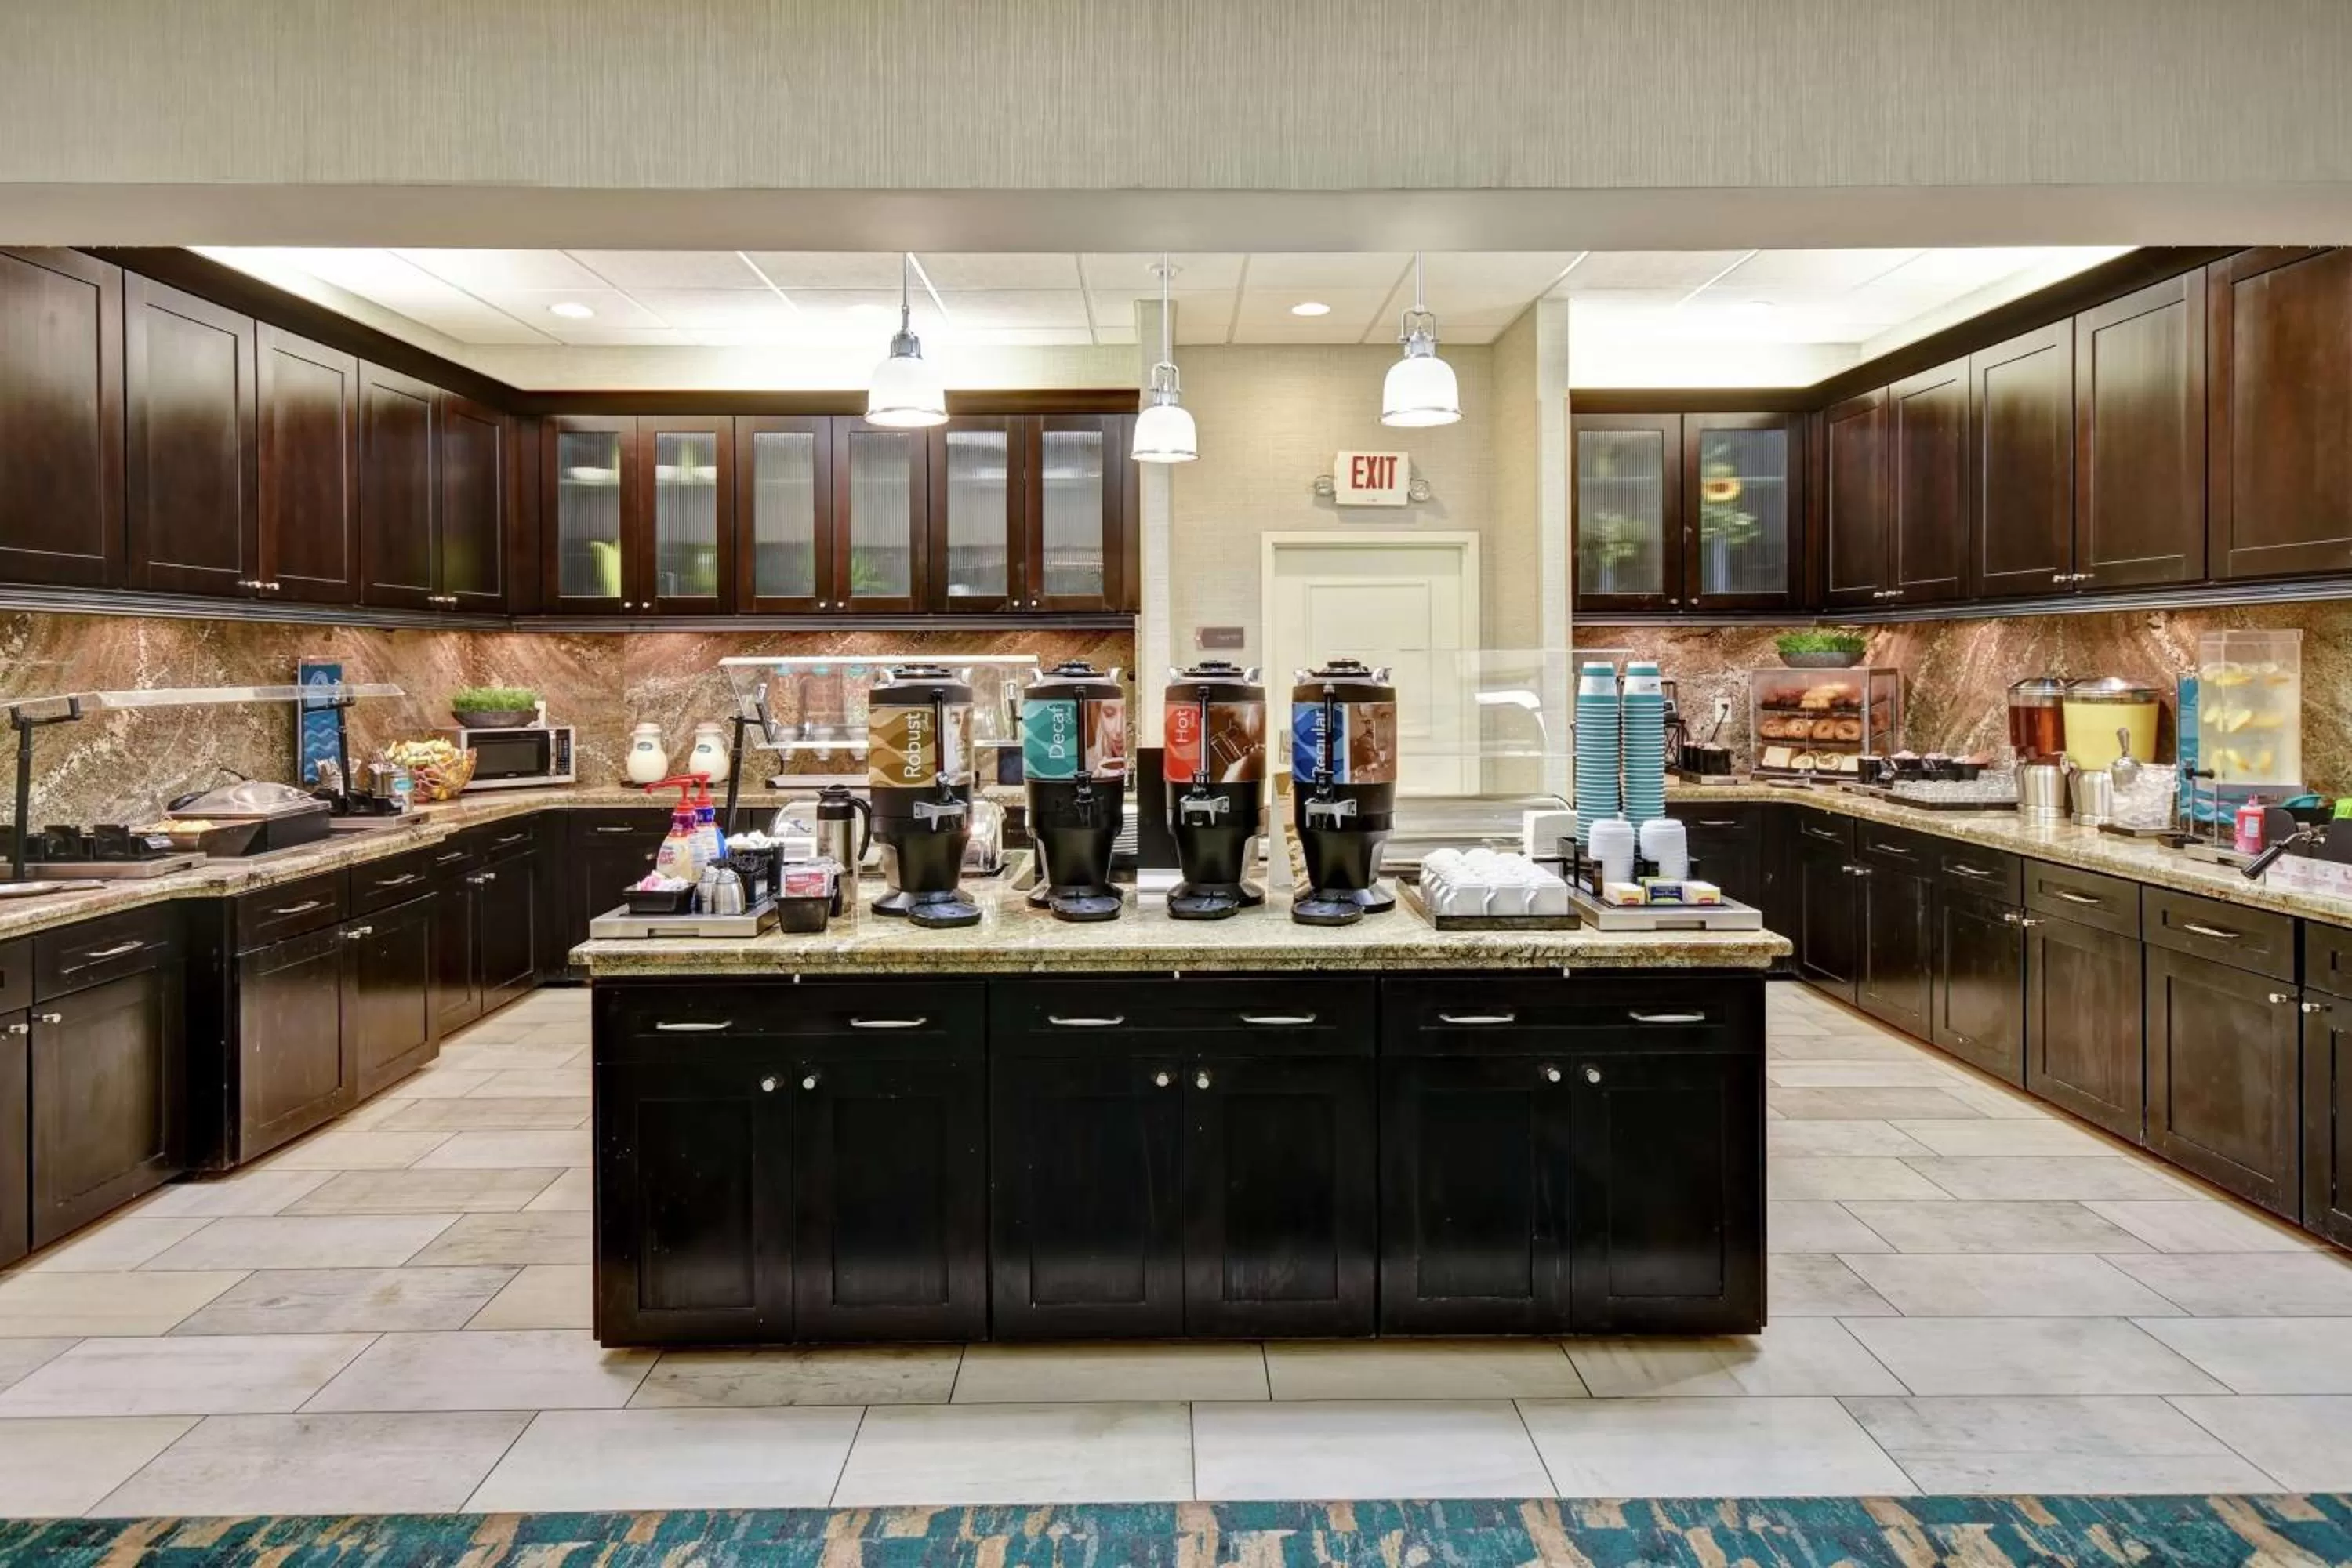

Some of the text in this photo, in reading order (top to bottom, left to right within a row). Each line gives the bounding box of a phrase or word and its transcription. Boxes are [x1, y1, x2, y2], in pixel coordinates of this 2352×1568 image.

[1352, 456, 1398, 489] EXIT
[903, 713, 921, 777] Robust
[1047, 705, 1065, 759] Decaf
[1175, 710, 1189, 742] Hot
